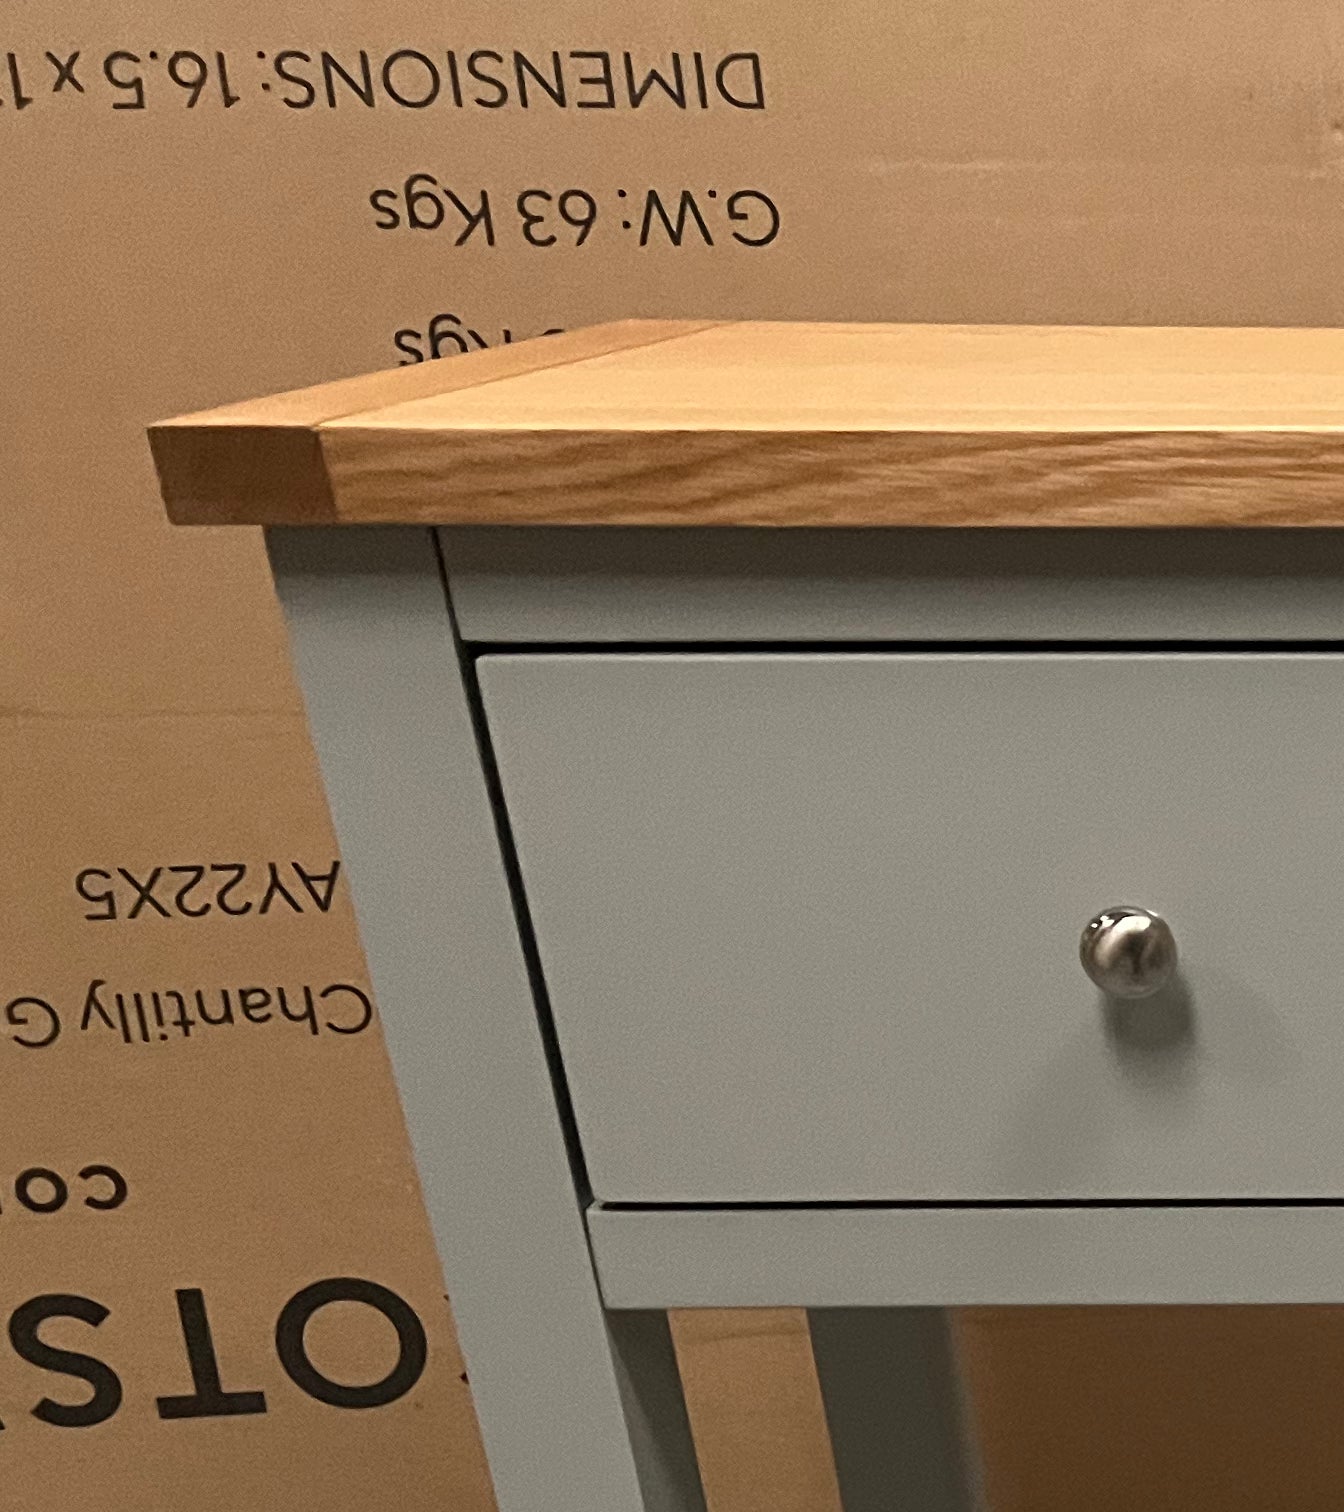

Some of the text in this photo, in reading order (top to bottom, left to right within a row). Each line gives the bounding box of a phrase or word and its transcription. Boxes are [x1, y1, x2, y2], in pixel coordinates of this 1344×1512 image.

[44, 50, 86, 93] x
[103, 50, 241, 110] 16.5
[256, 49, 767, 111] DIMENSIONS:
[369, 173, 781, 248] G.W: 63 Kgs
[75, 860, 341, 922] AY22X5
[80, 979, 374, 1045] Chantilly
[0, 1164, 128, 1215] CO
[0, 1276, 468, 1432] OTS
